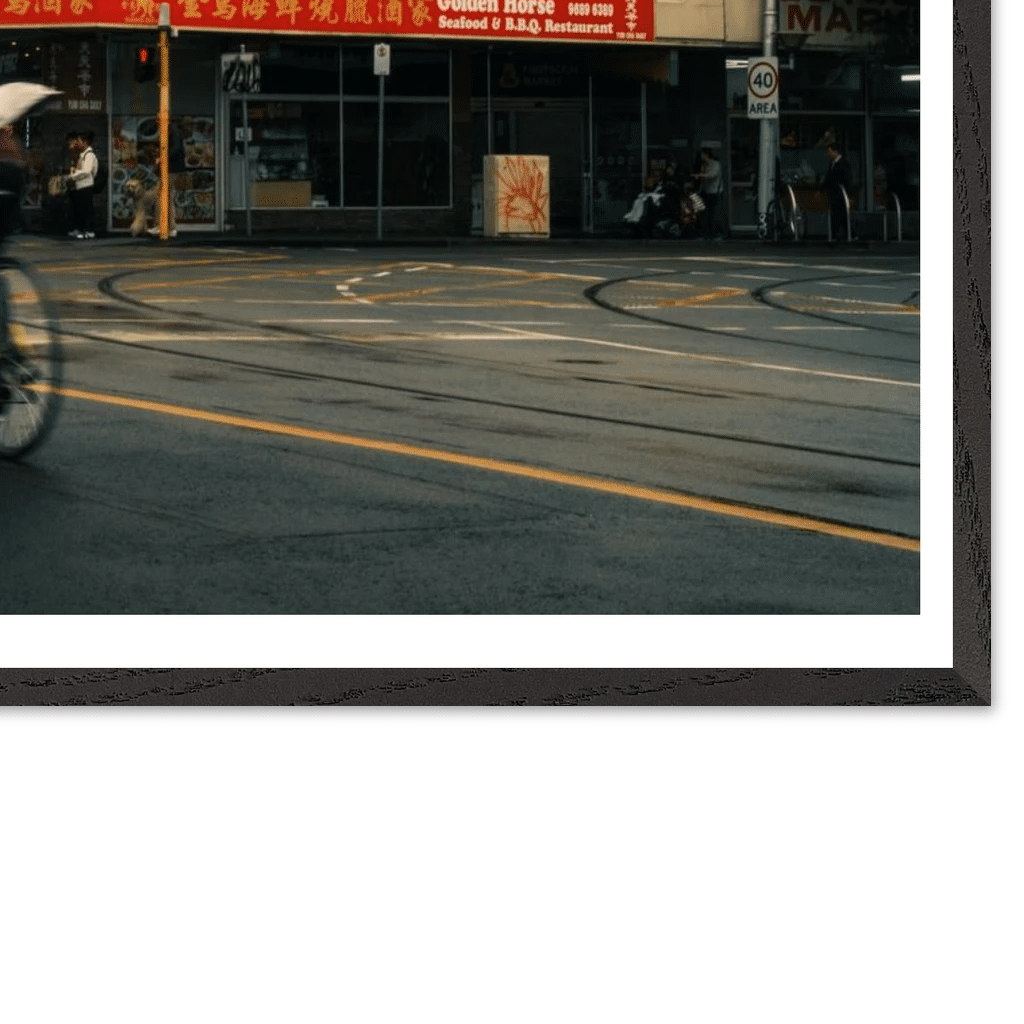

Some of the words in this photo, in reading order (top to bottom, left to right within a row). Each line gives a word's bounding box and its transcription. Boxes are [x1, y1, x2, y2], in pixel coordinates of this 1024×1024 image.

[438, 15, 488, 30] Seafood
[505, 17, 542, 35] B.B.Q.
[544, 19, 614, 34] Restaurant
[753, 72, 773, 89] 40
[749, 102, 777, 114] AREA
